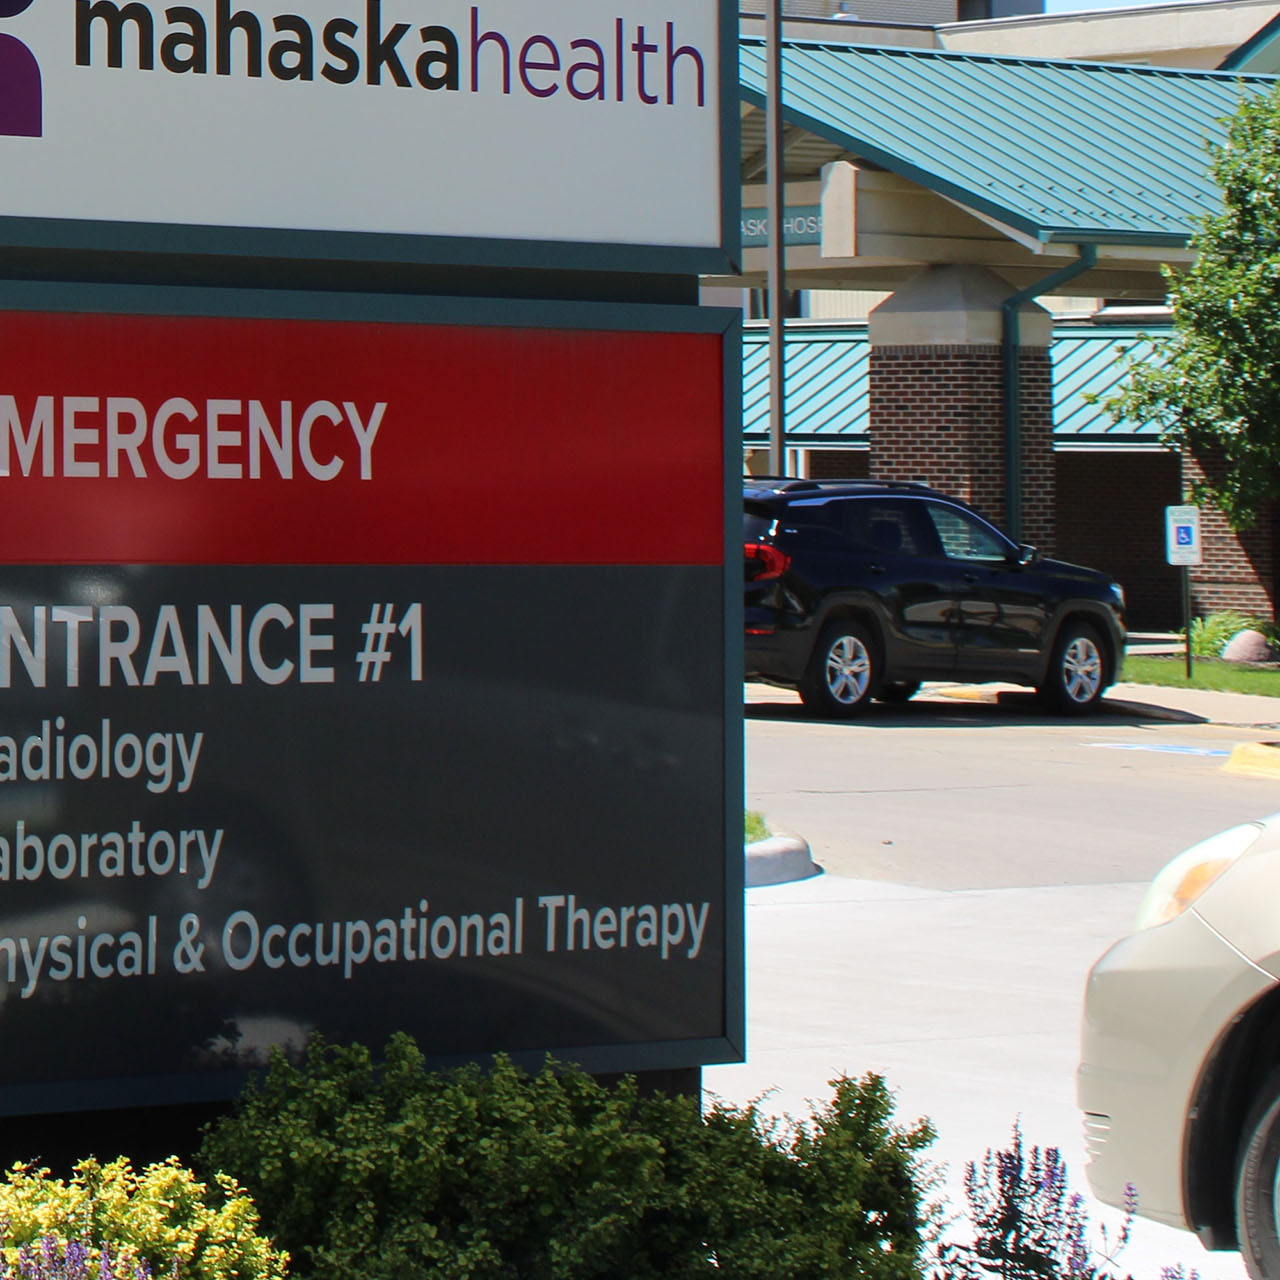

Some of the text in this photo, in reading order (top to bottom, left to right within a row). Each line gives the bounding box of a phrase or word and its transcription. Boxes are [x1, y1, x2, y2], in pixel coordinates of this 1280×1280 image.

[356, 602, 426, 683] #1
[174, 913, 205, 972] &
[222, 898, 523, 979] Occupational
[538, 895, 709, 961] Therapy
